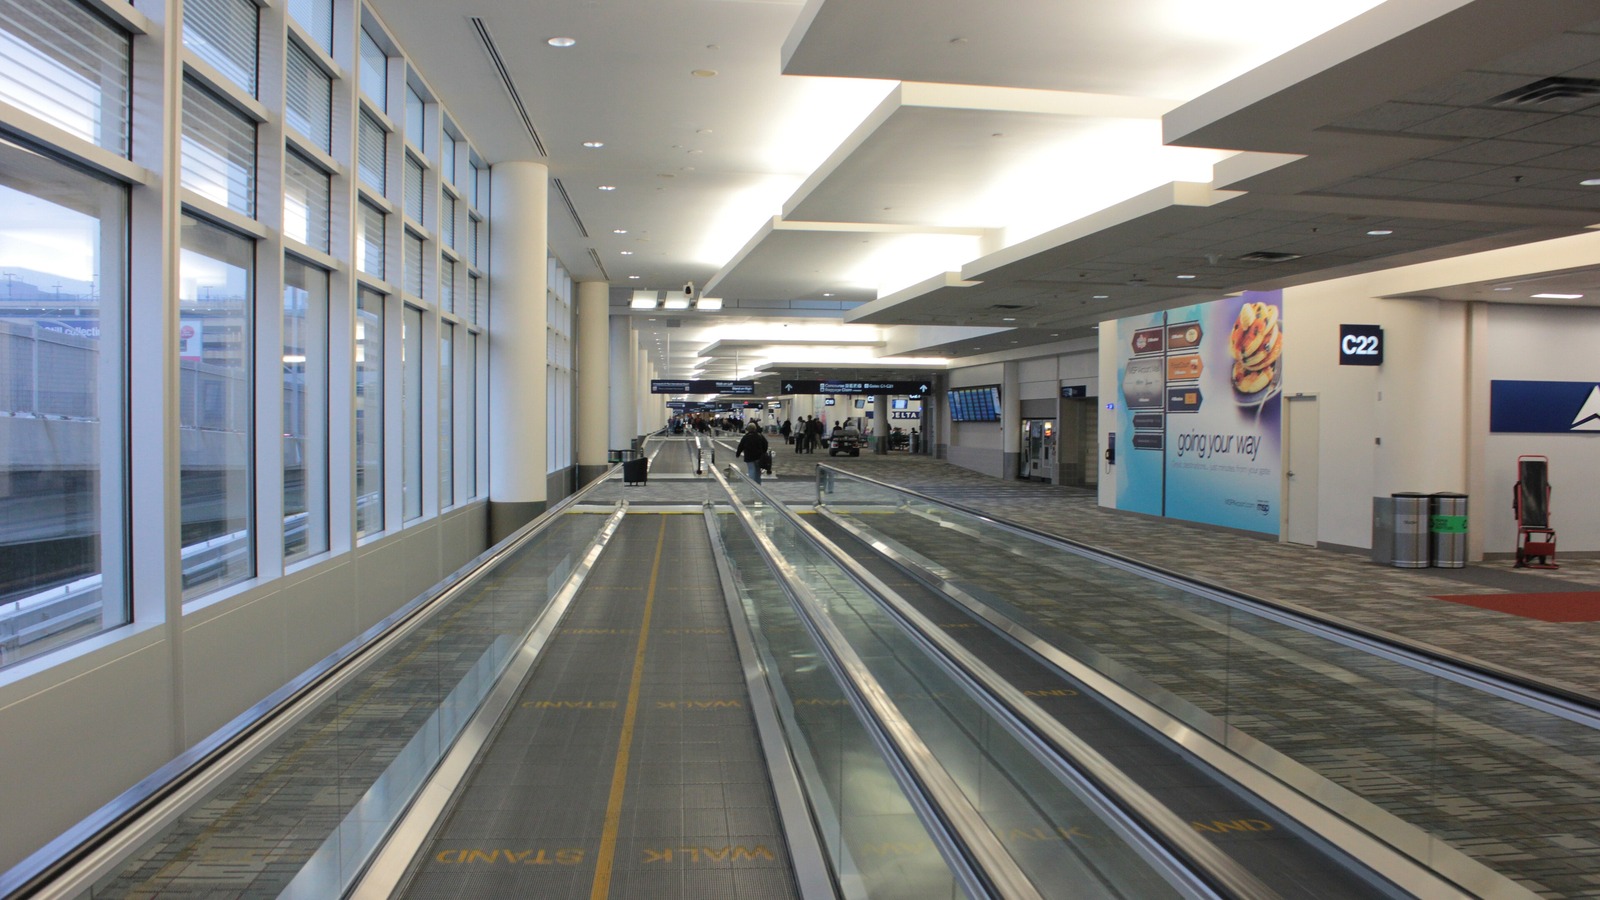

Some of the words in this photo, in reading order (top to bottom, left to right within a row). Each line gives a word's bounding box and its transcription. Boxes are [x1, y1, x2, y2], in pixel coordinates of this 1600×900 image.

[1341, 334, 1379, 355] C22
[1177, 428, 1207, 458] going
[1207, 434, 1233, 459] your
[1236, 434, 1261, 462] way
[435, 848, 586, 865] STAND
[642, 845, 775, 864] WALK
